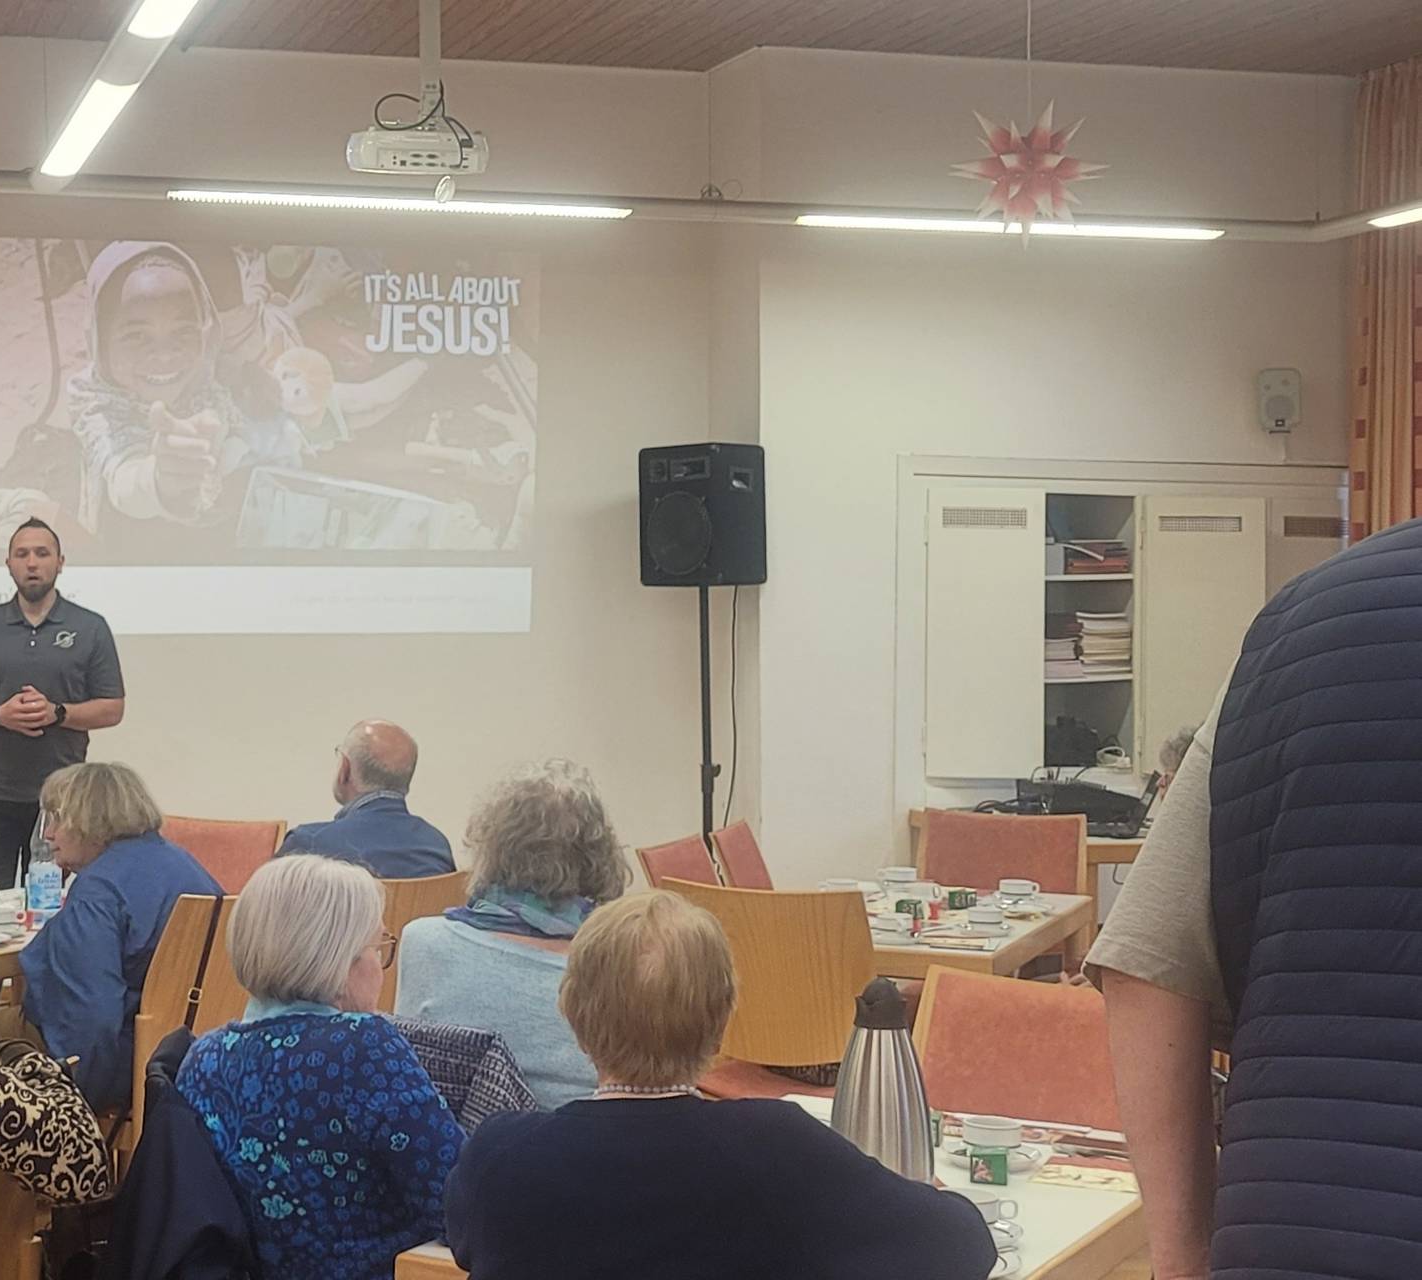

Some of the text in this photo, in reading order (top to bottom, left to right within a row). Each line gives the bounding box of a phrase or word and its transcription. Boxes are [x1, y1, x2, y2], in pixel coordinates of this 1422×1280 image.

[364, 269, 521, 306] IT'S ALL ABOUT
[365, 303, 511, 356] JESUS!
